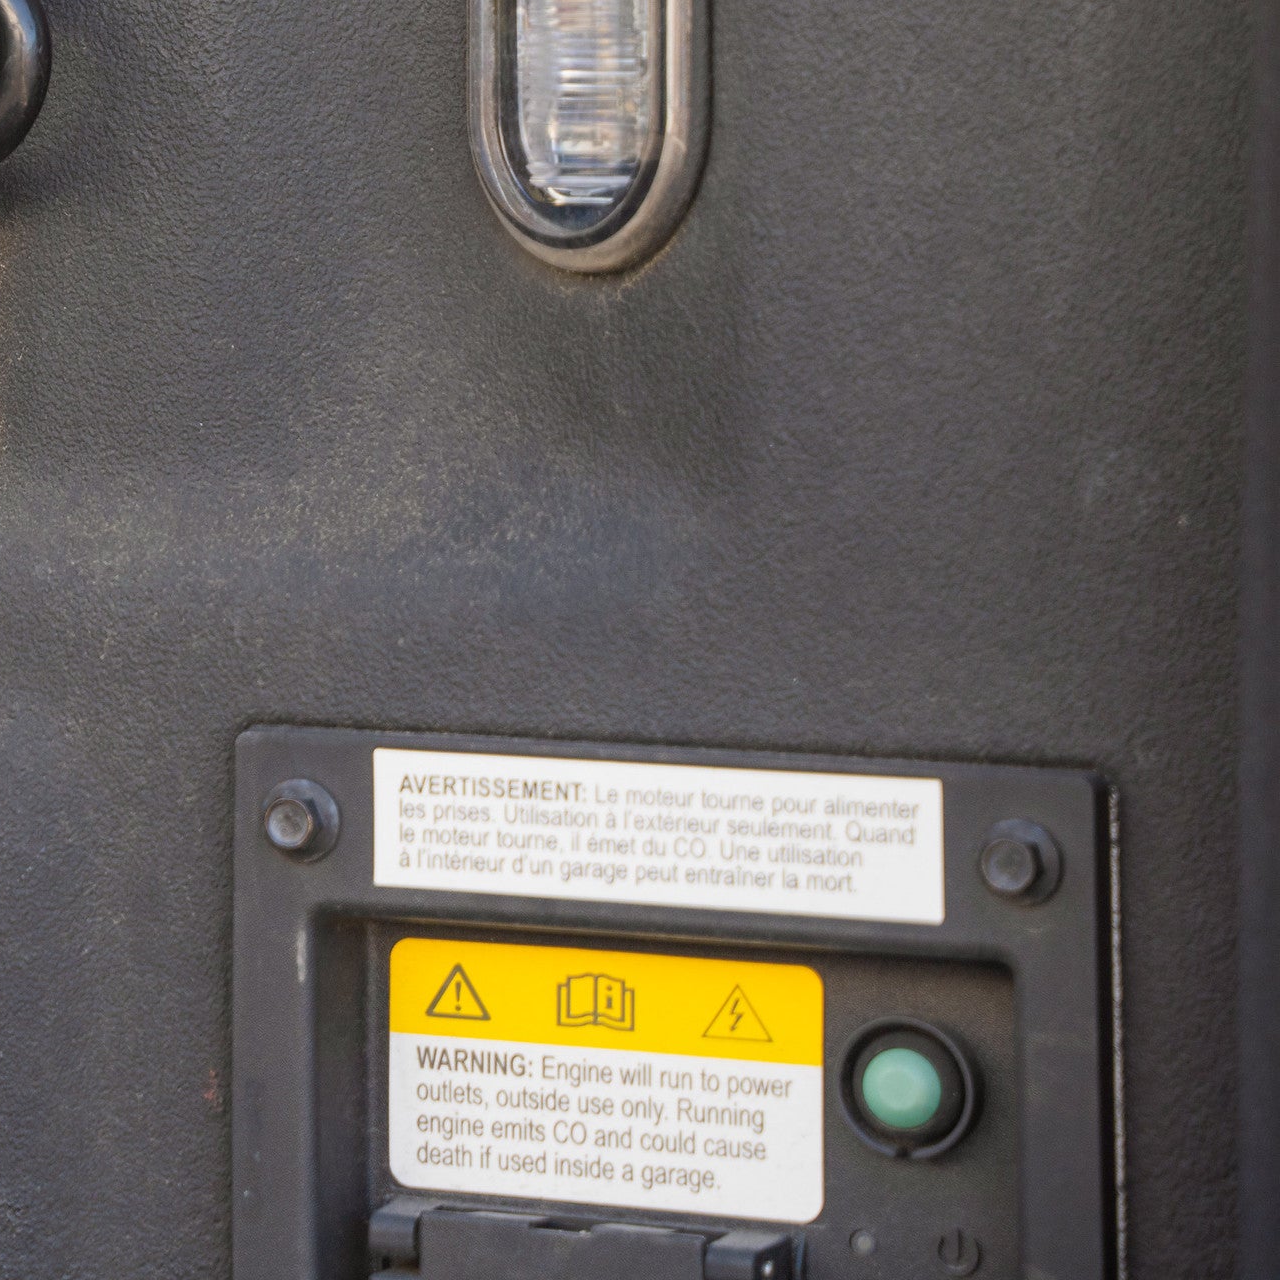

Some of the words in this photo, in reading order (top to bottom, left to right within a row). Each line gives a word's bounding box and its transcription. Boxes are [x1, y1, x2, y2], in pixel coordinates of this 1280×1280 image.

[398, 773, 587, 803] AVERTISSEMENT:
[595, 784, 619, 808] Le
[626, 788, 695, 809] moteur
[700, 789, 765, 812] tourne
[771, 796, 817, 819] pour
[823, 795, 919, 821] alimenter
[399, 797, 426, 820] les
[504, 803, 601, 828] Utilisation
[605, 807, 618, 831] à
[623, 810, 720, 834] l'extérieur
[727, 814, 836, 841] seulement.
[844, 819, 917, 845] Quand
[399, 822, 415, 845] le
[422, 822, 490, 848] moteur
[571, 831, 580, 852] il
[586, 832, 636, 856] émet
[642, 836, 667, 858] du
[720, 838, 761, 863] Une
[767, 843, 864, 868] utilisation
[399, 847, 411, 869] à
[417, 847, 506, 874] l'intérieur
[512, 853, 554, 876] d'un
[559, 853, 628, 884] garage
[635, 863, 678, 886] peut
[684, 860, 775, 890] entraîner
[782, 867, 801, 891] la
[806, 867, 856, 894] mort.
[416, 1045, 533, 1079] WARNING:
[541, 1054, 614, 1088] Engine
[619, 1063, 652, 1087] will
[659, 1070, 693, 1091] run
[700, 1069, 720, 1093] to
[727, 1076, 793, 1102] power
[416, 1079, 489, 1111] outlets,
[496, 1086, 570, 1113] outside
[577, 1096, 614, 1117] use
[621, 1096, 668, 1126] only.
[677, 1097, 766, 1132] Running
[416, 1111, 484, 1141] engine
[490, 1117, 546, 1143] emits
[553, 1119, 588, 1146] CO
[593, 1126, 633, 1151] and
[640, 1130, 697, 1156] could
[703, 1138, 767, 1161] cause
[416, 1140, 473, 1168] death
[480, 1145, 493, 1169] if
[497, 1150, 547, 1176] used
[554, 1152, 615, 1183] inside
[621, 1163, 634, 1183] a
[640, 1165, 721, 1194] garage.
